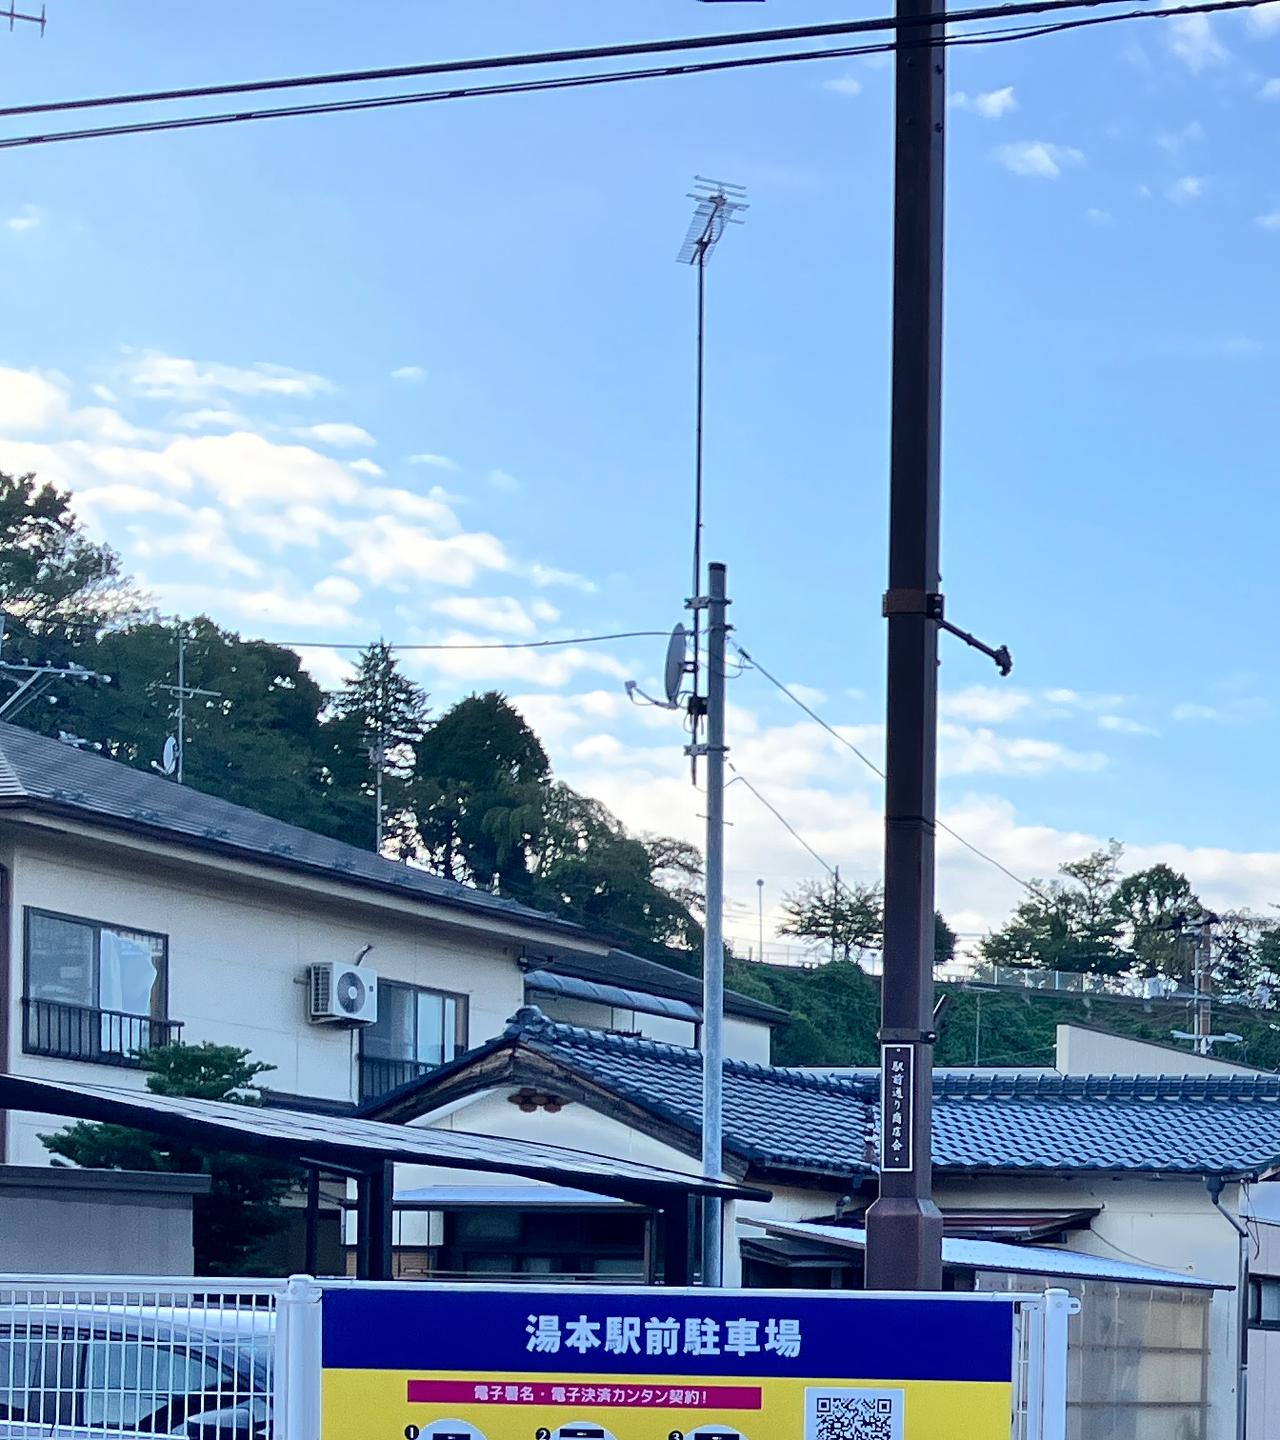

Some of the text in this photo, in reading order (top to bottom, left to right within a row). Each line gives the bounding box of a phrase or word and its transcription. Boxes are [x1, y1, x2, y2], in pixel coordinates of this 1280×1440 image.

[891, 1060, 905, 1151] 駅前通り商店会
[525, 1314, 801, 1358] 湯本駅前駐車場
